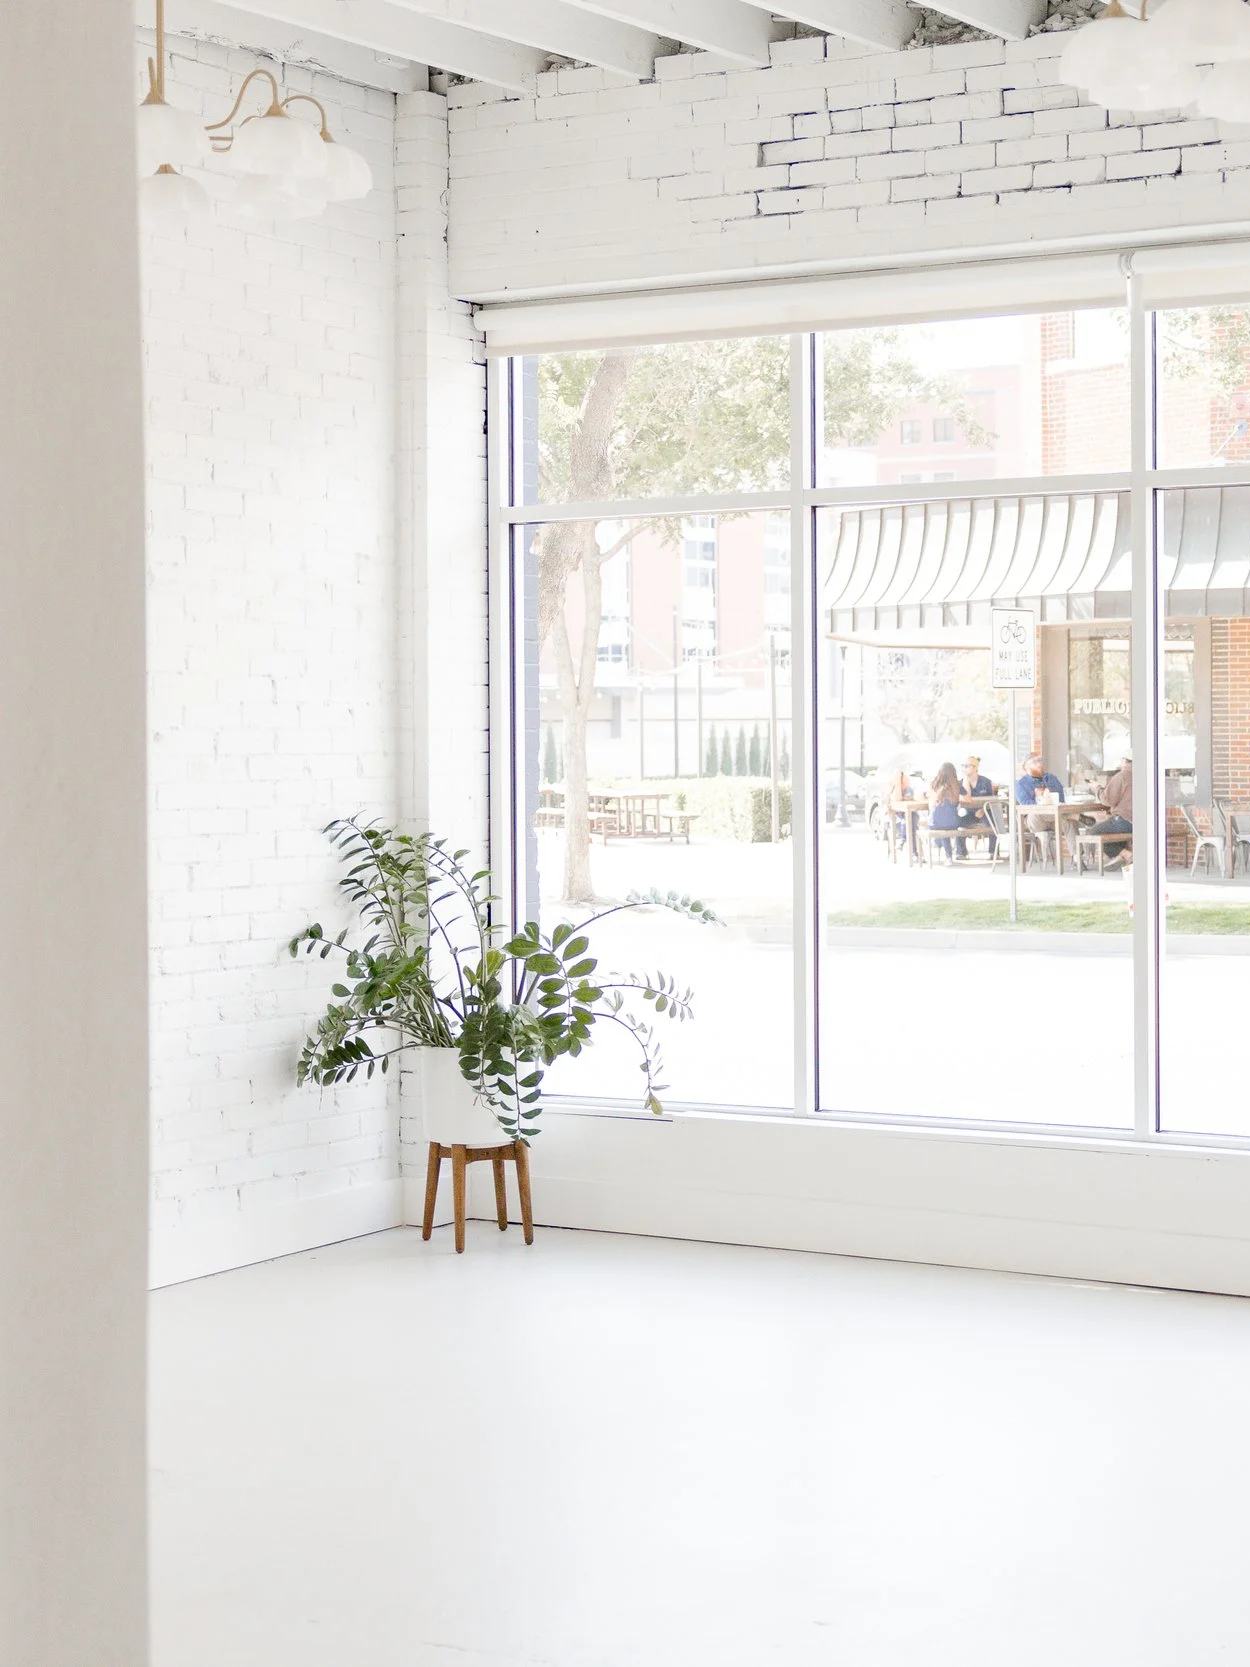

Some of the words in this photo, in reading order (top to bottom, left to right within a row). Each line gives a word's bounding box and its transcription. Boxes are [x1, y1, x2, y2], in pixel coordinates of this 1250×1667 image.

[999, 650, 1012, 662] MAY
[1016, 650, 1028, 662] USE
[996, 667, 1012, 680] FULL
[1015, 667, 1032, 680] LANE
